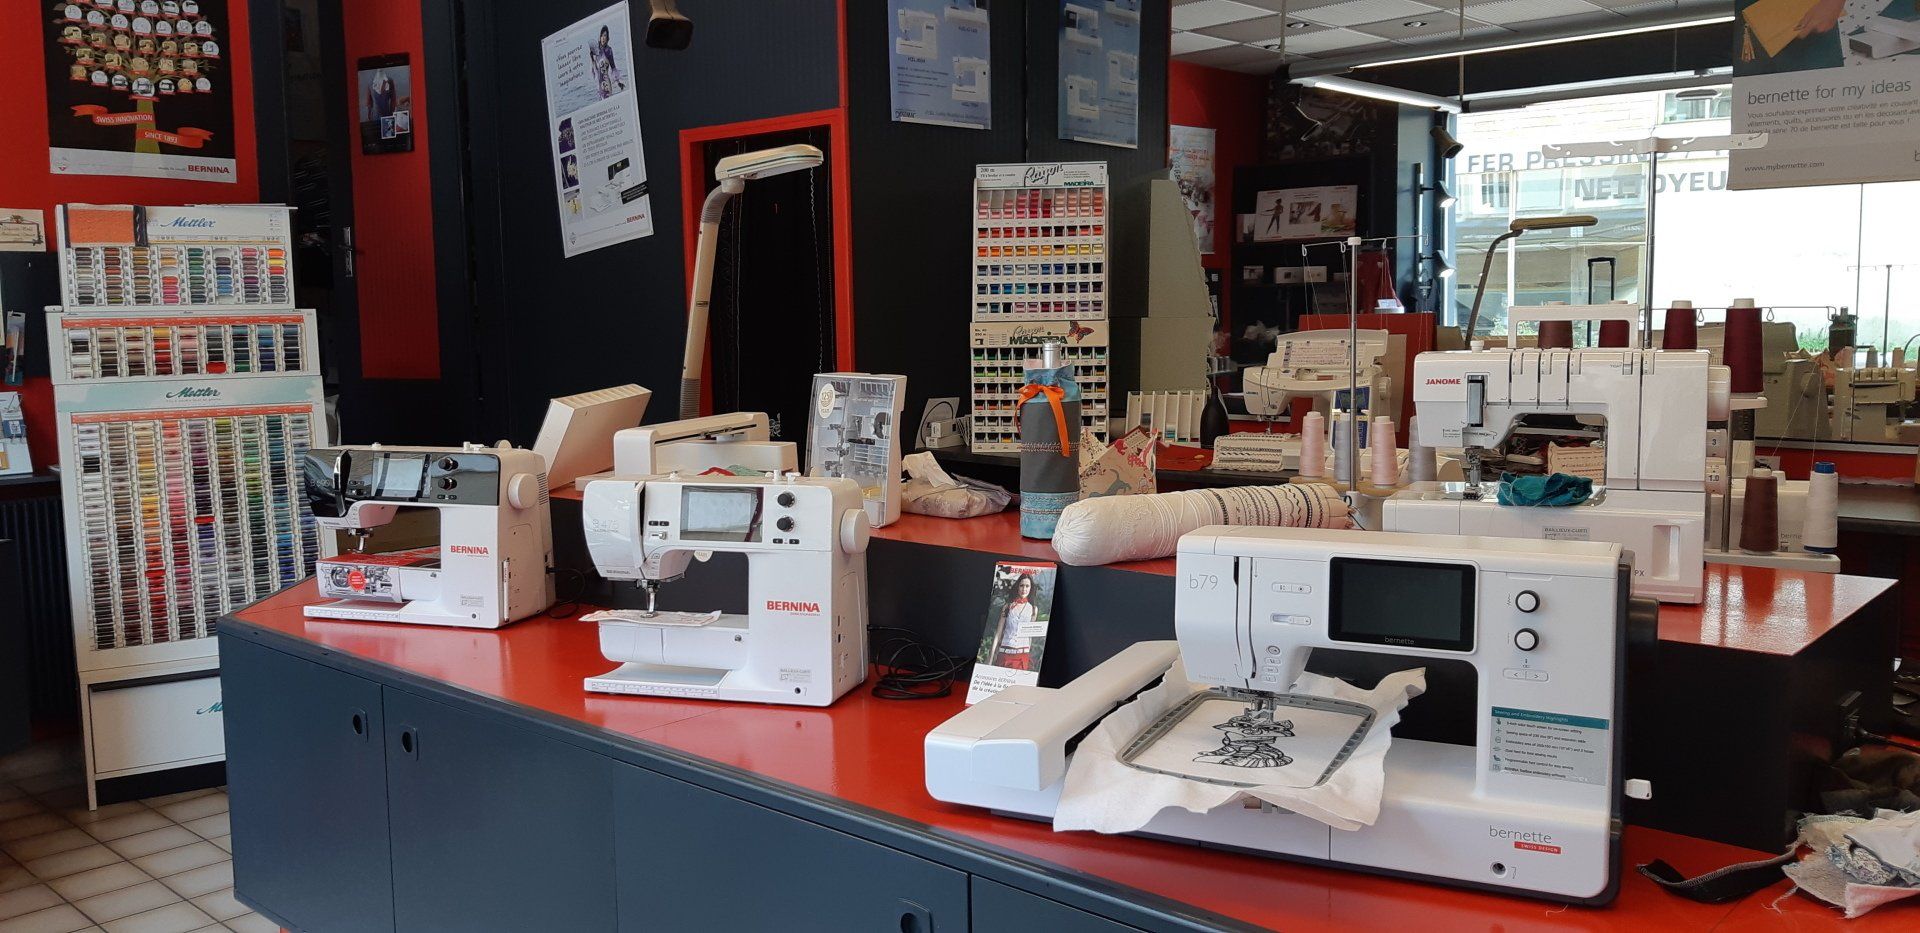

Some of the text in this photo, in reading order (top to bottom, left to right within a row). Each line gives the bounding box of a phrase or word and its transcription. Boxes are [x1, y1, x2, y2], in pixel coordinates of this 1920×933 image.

[1747, 79, 1912, 105] bernette for my ideas
[115, 114, 153, 122] INNOVATION
[144, 131, 178, 143] SINCE 1893
[1468, 152, 1514, 173] FER
[1744, 162, 1825, 172] www.mybernette.com
[187, 164, 230, 174] BERNINA
[1063, 179, 1095, 187] MADEIRA
[160, 216, 217, 228] Mettler
[626, 213, 645, 224] BERNINA
[1425, 378, 1462, 386] JANOME
[165, 386, 221, 399] Mettler
[1707, 473, 1720, 482] 1.0
[450, 545, 490, 556] BERNINA
[1010, 568, 1037, 576] BERNINA
[1189, 573, 1219, 591] b79
[766, 600, 821, 613] BERNINA
[1384, 635, 1415, 646] bernette
[1494, 709, 1511, 717] Sewing
[1520, 712, 1546, 721] Embroidery
[1489, 825, 1553, 844] bernette
[1521, 842, 1559, 854] SWISS DESIGN
